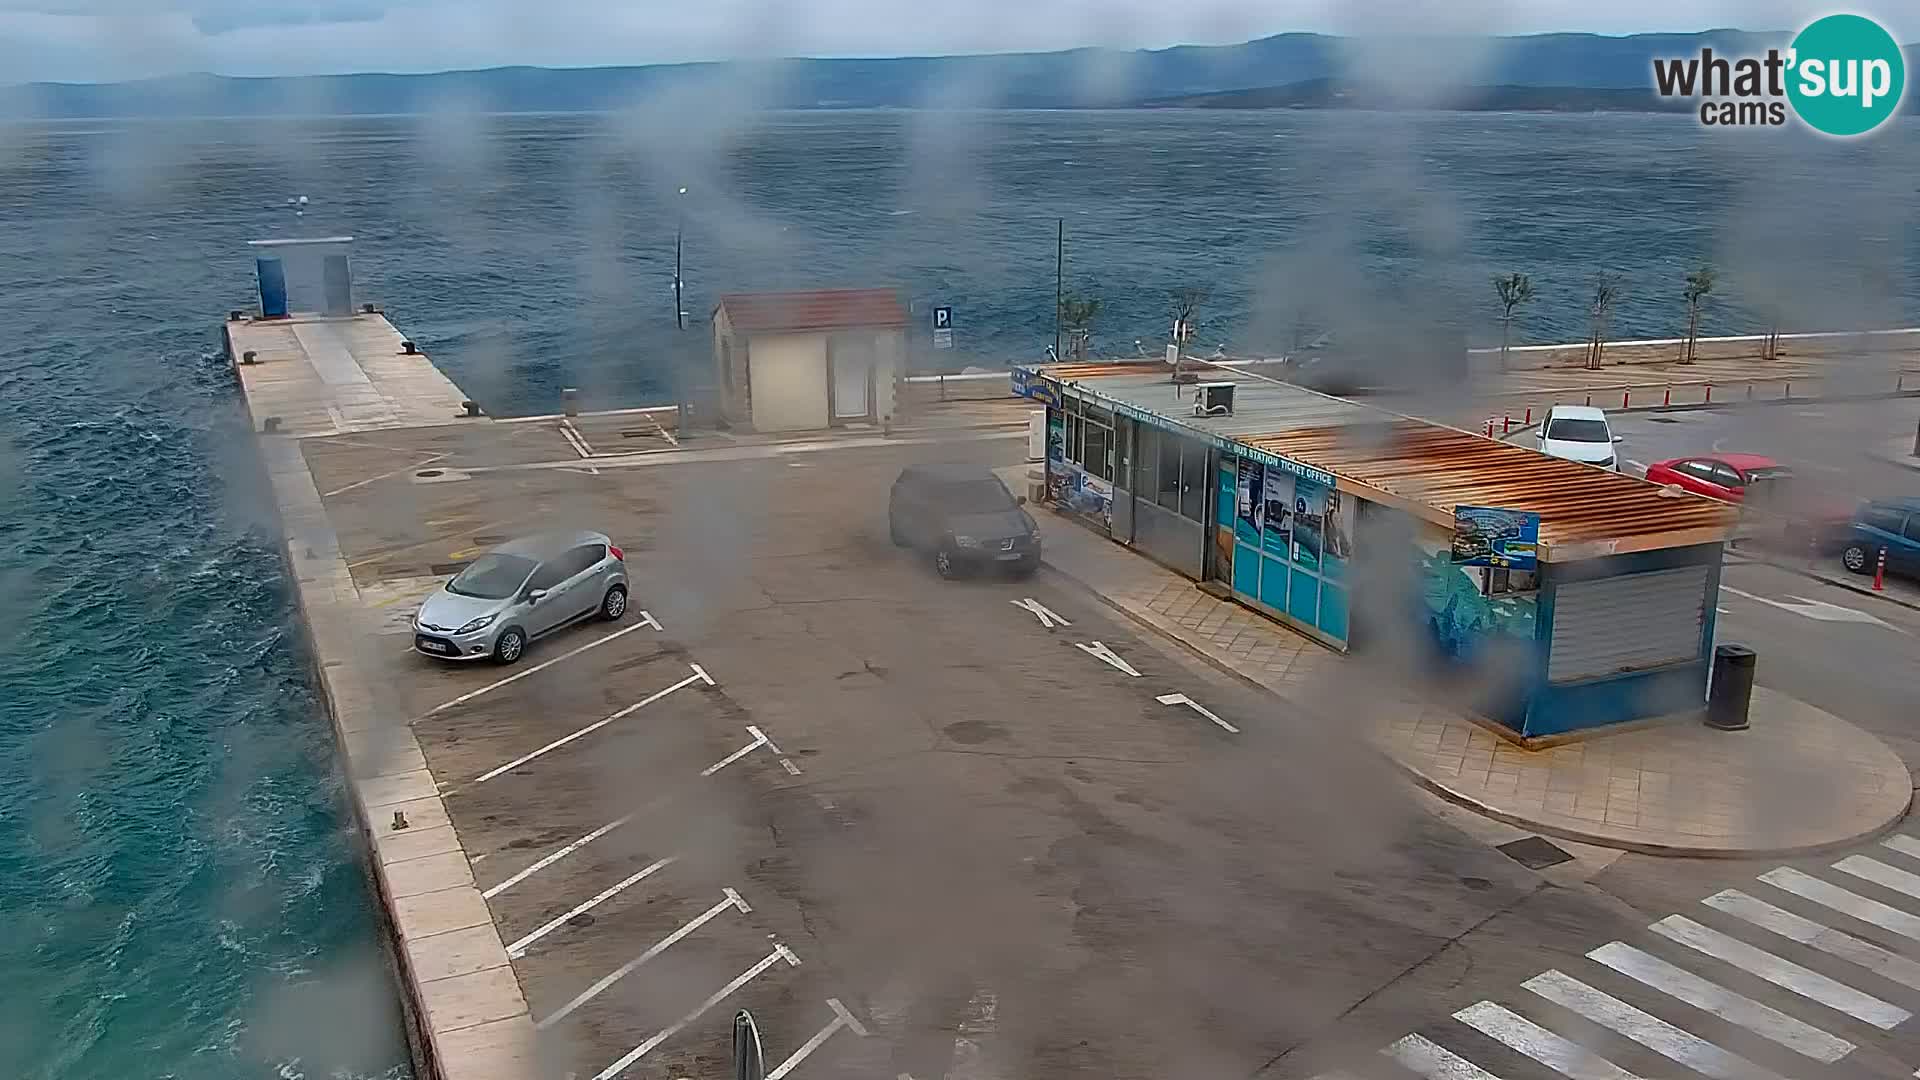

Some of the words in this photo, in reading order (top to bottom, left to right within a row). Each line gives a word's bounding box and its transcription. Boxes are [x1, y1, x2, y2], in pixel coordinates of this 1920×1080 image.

[937, 310, 947, 326] P
[1233, 445, 1248, 457] BUS
[1248, 449, 1278, 466] STATION
[1280, 459, 1305, 476] TICKET
[1306, 469, 1332, 485] OFFICE
